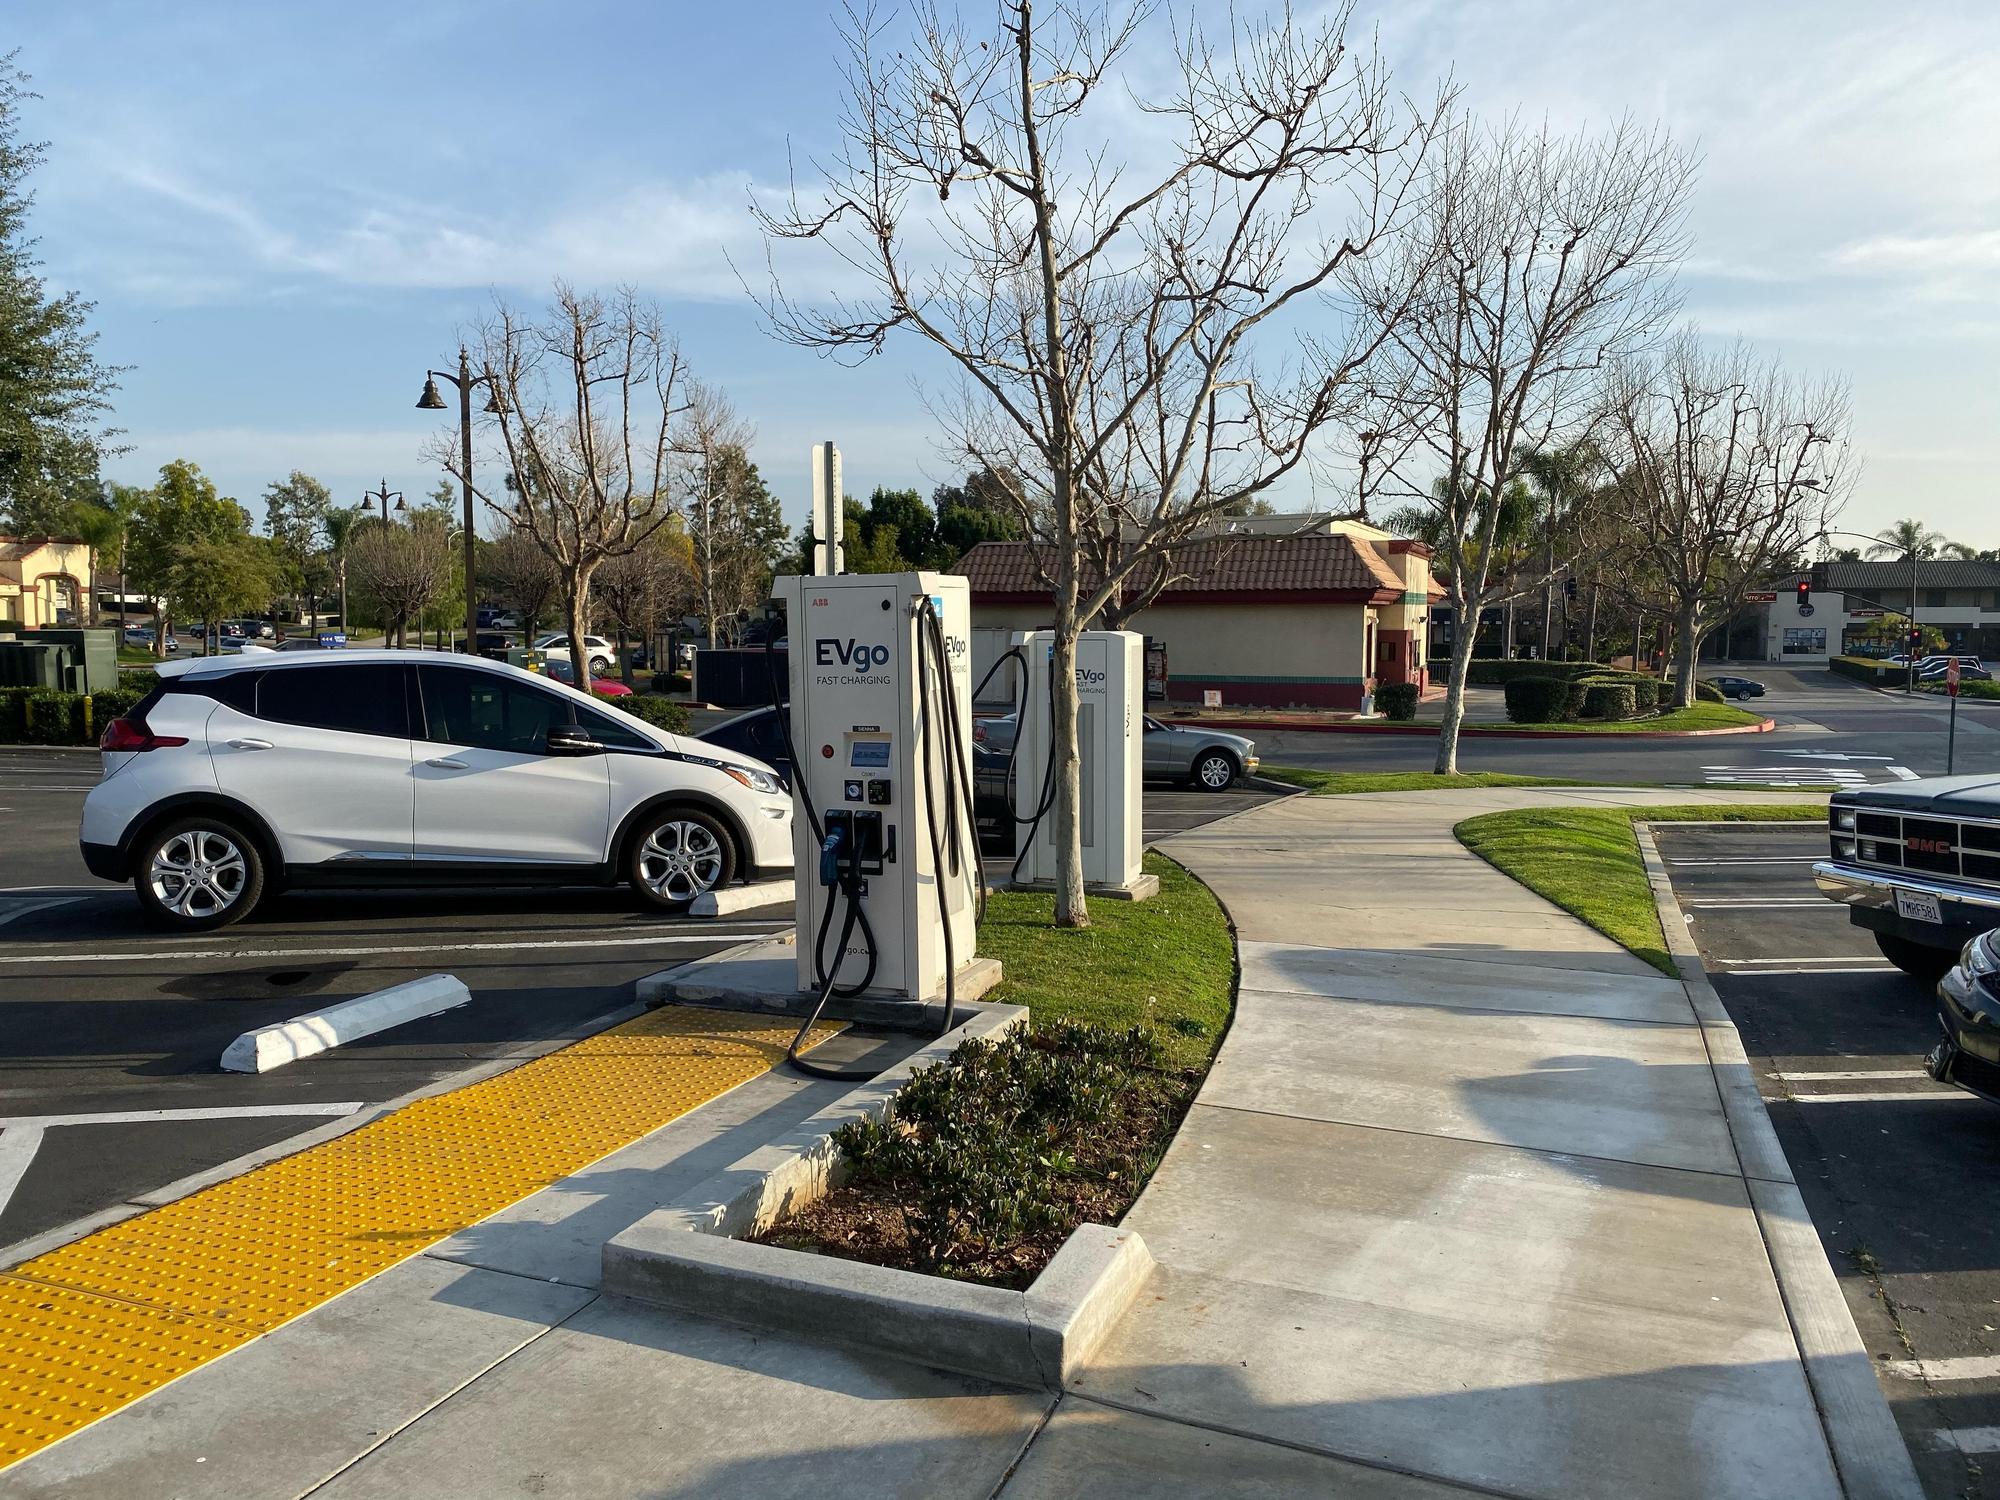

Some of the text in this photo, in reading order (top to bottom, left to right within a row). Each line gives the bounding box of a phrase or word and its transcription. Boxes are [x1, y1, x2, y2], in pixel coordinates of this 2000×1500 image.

[812, 598, 829, 607] ABB
[945, 635, 966, 658] EVgo
[816, 639, 889, 673] EVgo
[816, 676, 891, 685] FAST CHARGING
[1076, 669, 1105, 684] EVgo
[1908, 838, 1949, 853] GMC
